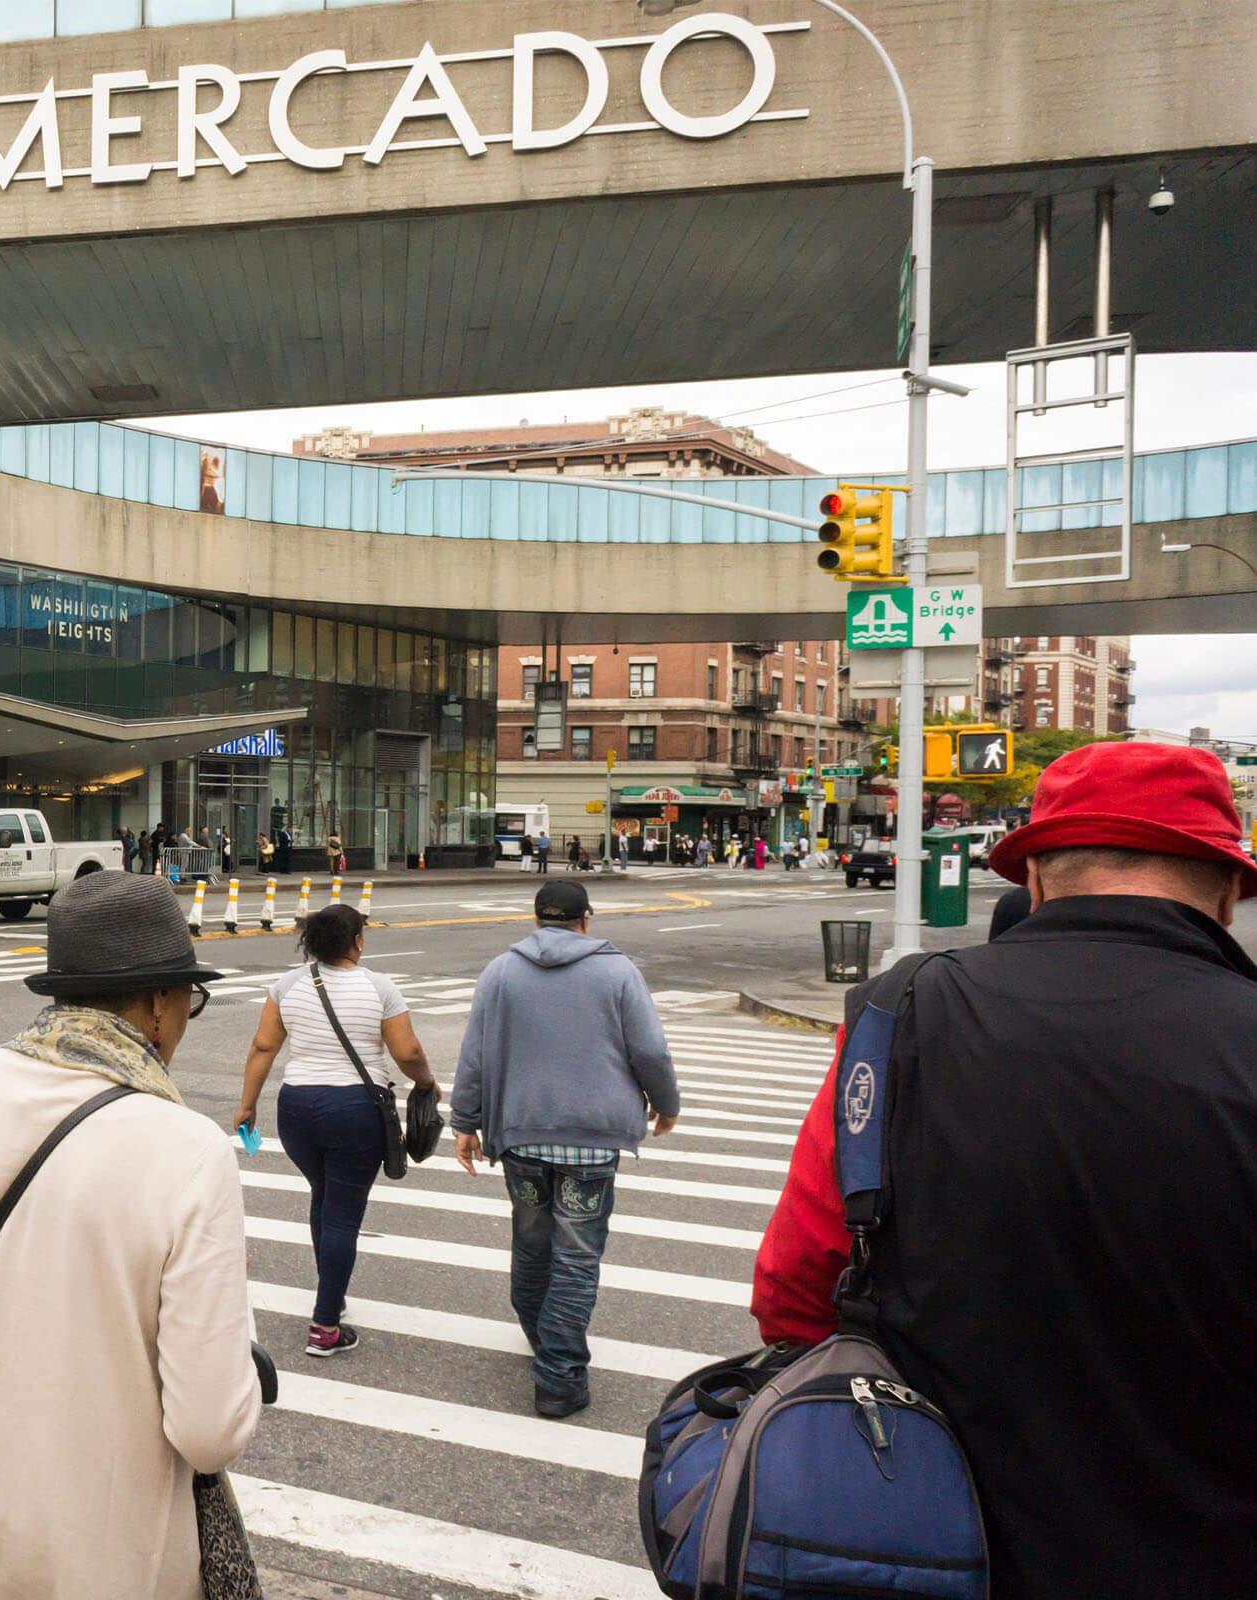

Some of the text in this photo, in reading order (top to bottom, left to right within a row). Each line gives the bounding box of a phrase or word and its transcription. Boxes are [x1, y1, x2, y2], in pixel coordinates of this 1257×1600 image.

[930, 589, 964, 602] G W
[919, 605, 975, 619] Bridge
[201, 728, 285, 760] arshalls
